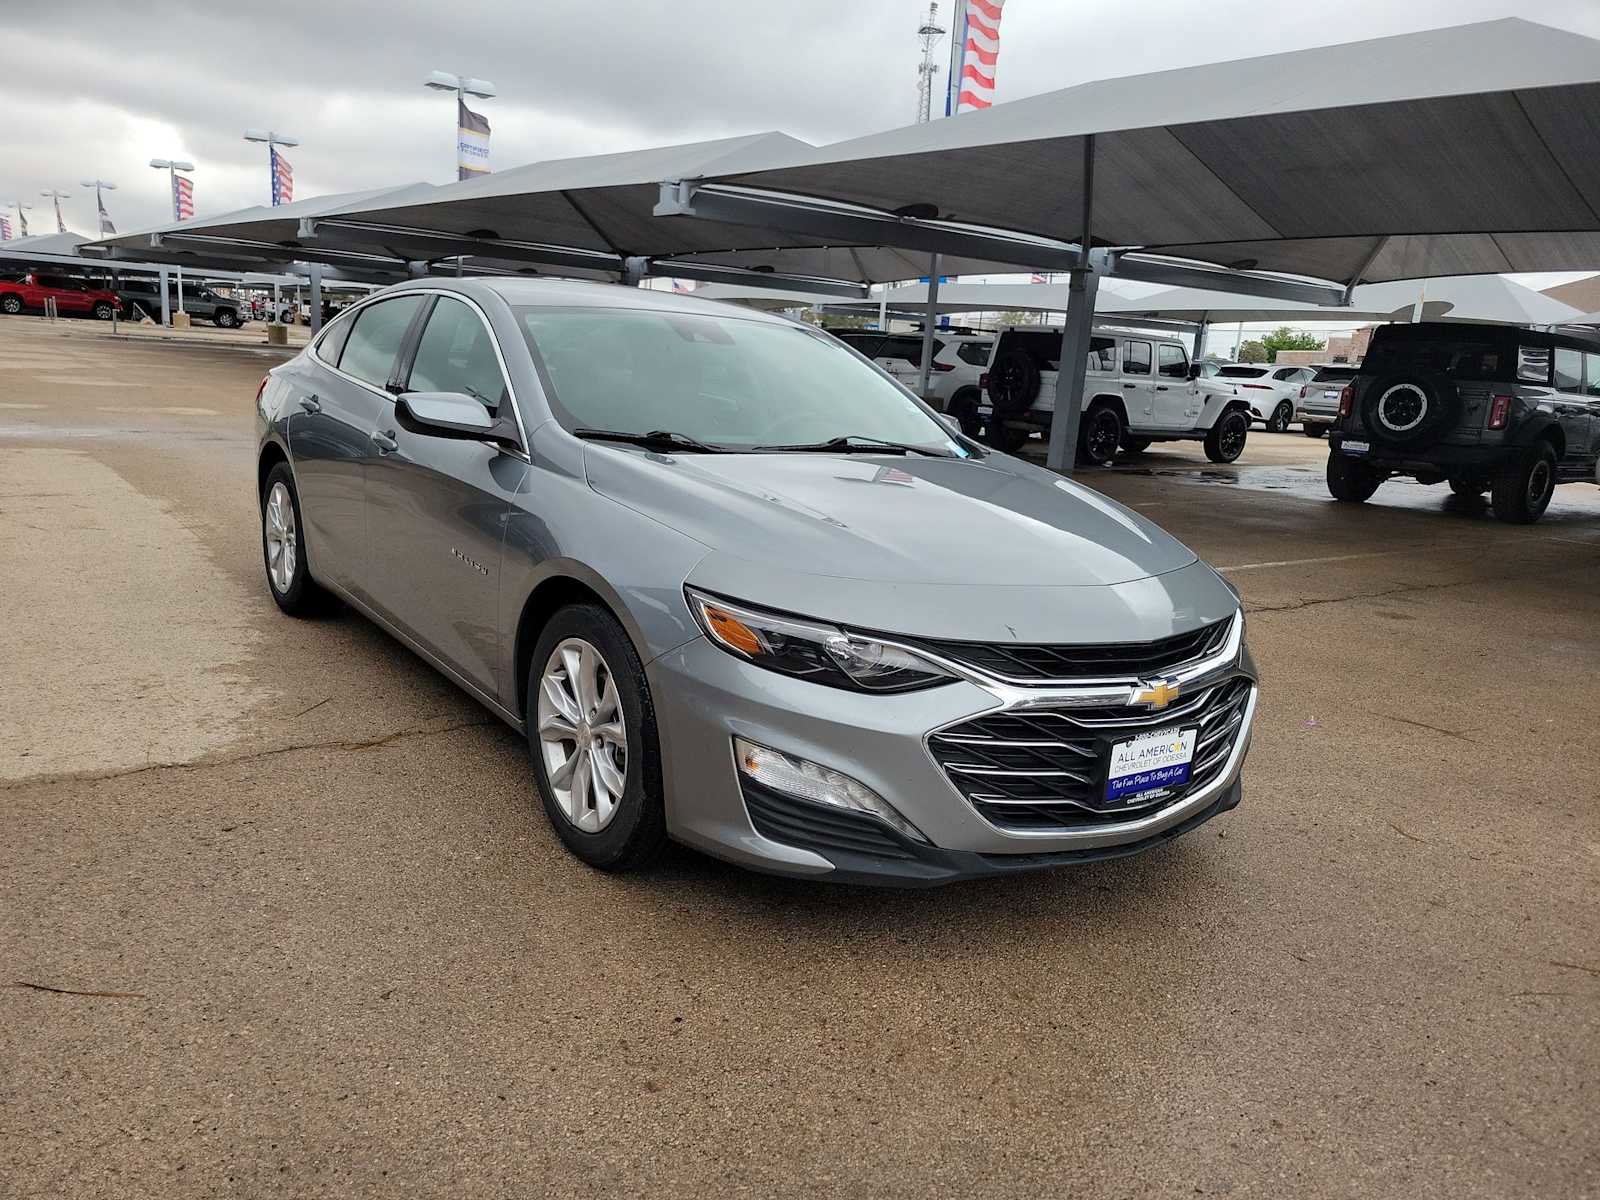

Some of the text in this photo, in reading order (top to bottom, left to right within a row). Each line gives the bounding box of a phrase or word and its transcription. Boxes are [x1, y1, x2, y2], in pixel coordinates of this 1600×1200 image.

[1114, 752, 1186, 772] CHEVROLET OF ODESSA
[1118, 752, 1135, 763] ALL
[1112, 779, 1123, 789] The
[1123, 778, 1134, 786] Fun
[1150, 772, 1156, 780] To
[1157, 771, 1168, 781] Buy
